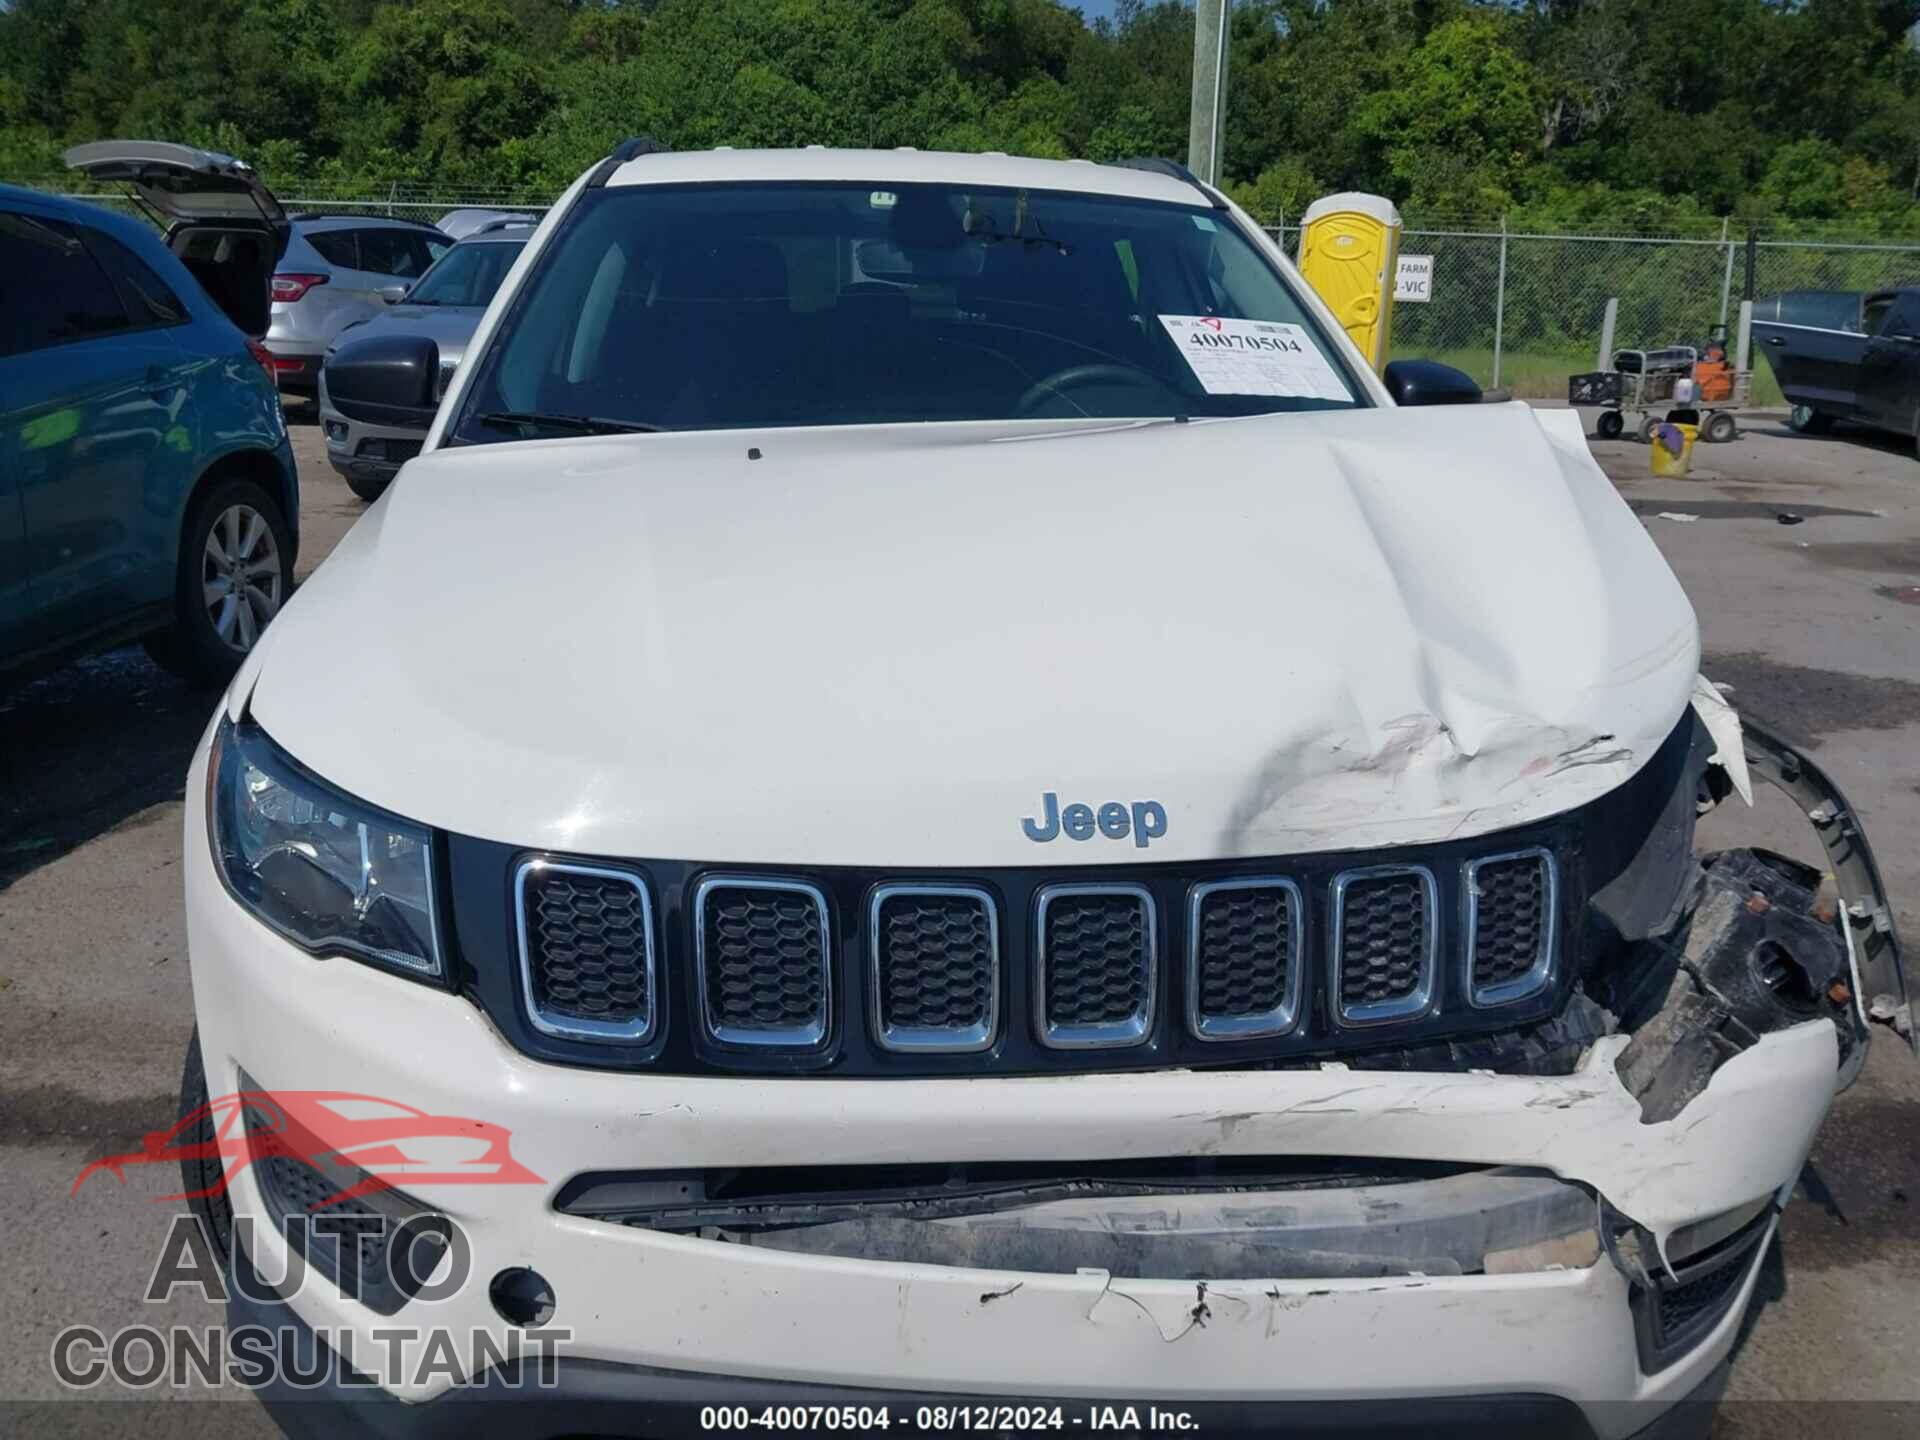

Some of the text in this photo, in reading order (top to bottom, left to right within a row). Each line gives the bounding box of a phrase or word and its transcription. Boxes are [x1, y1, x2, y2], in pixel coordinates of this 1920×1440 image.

[1401, 263, 1428, 273] FARM
[1190, 332, 1302, 353] 40070504
[1021, 792, 1168, 848] Jeep
